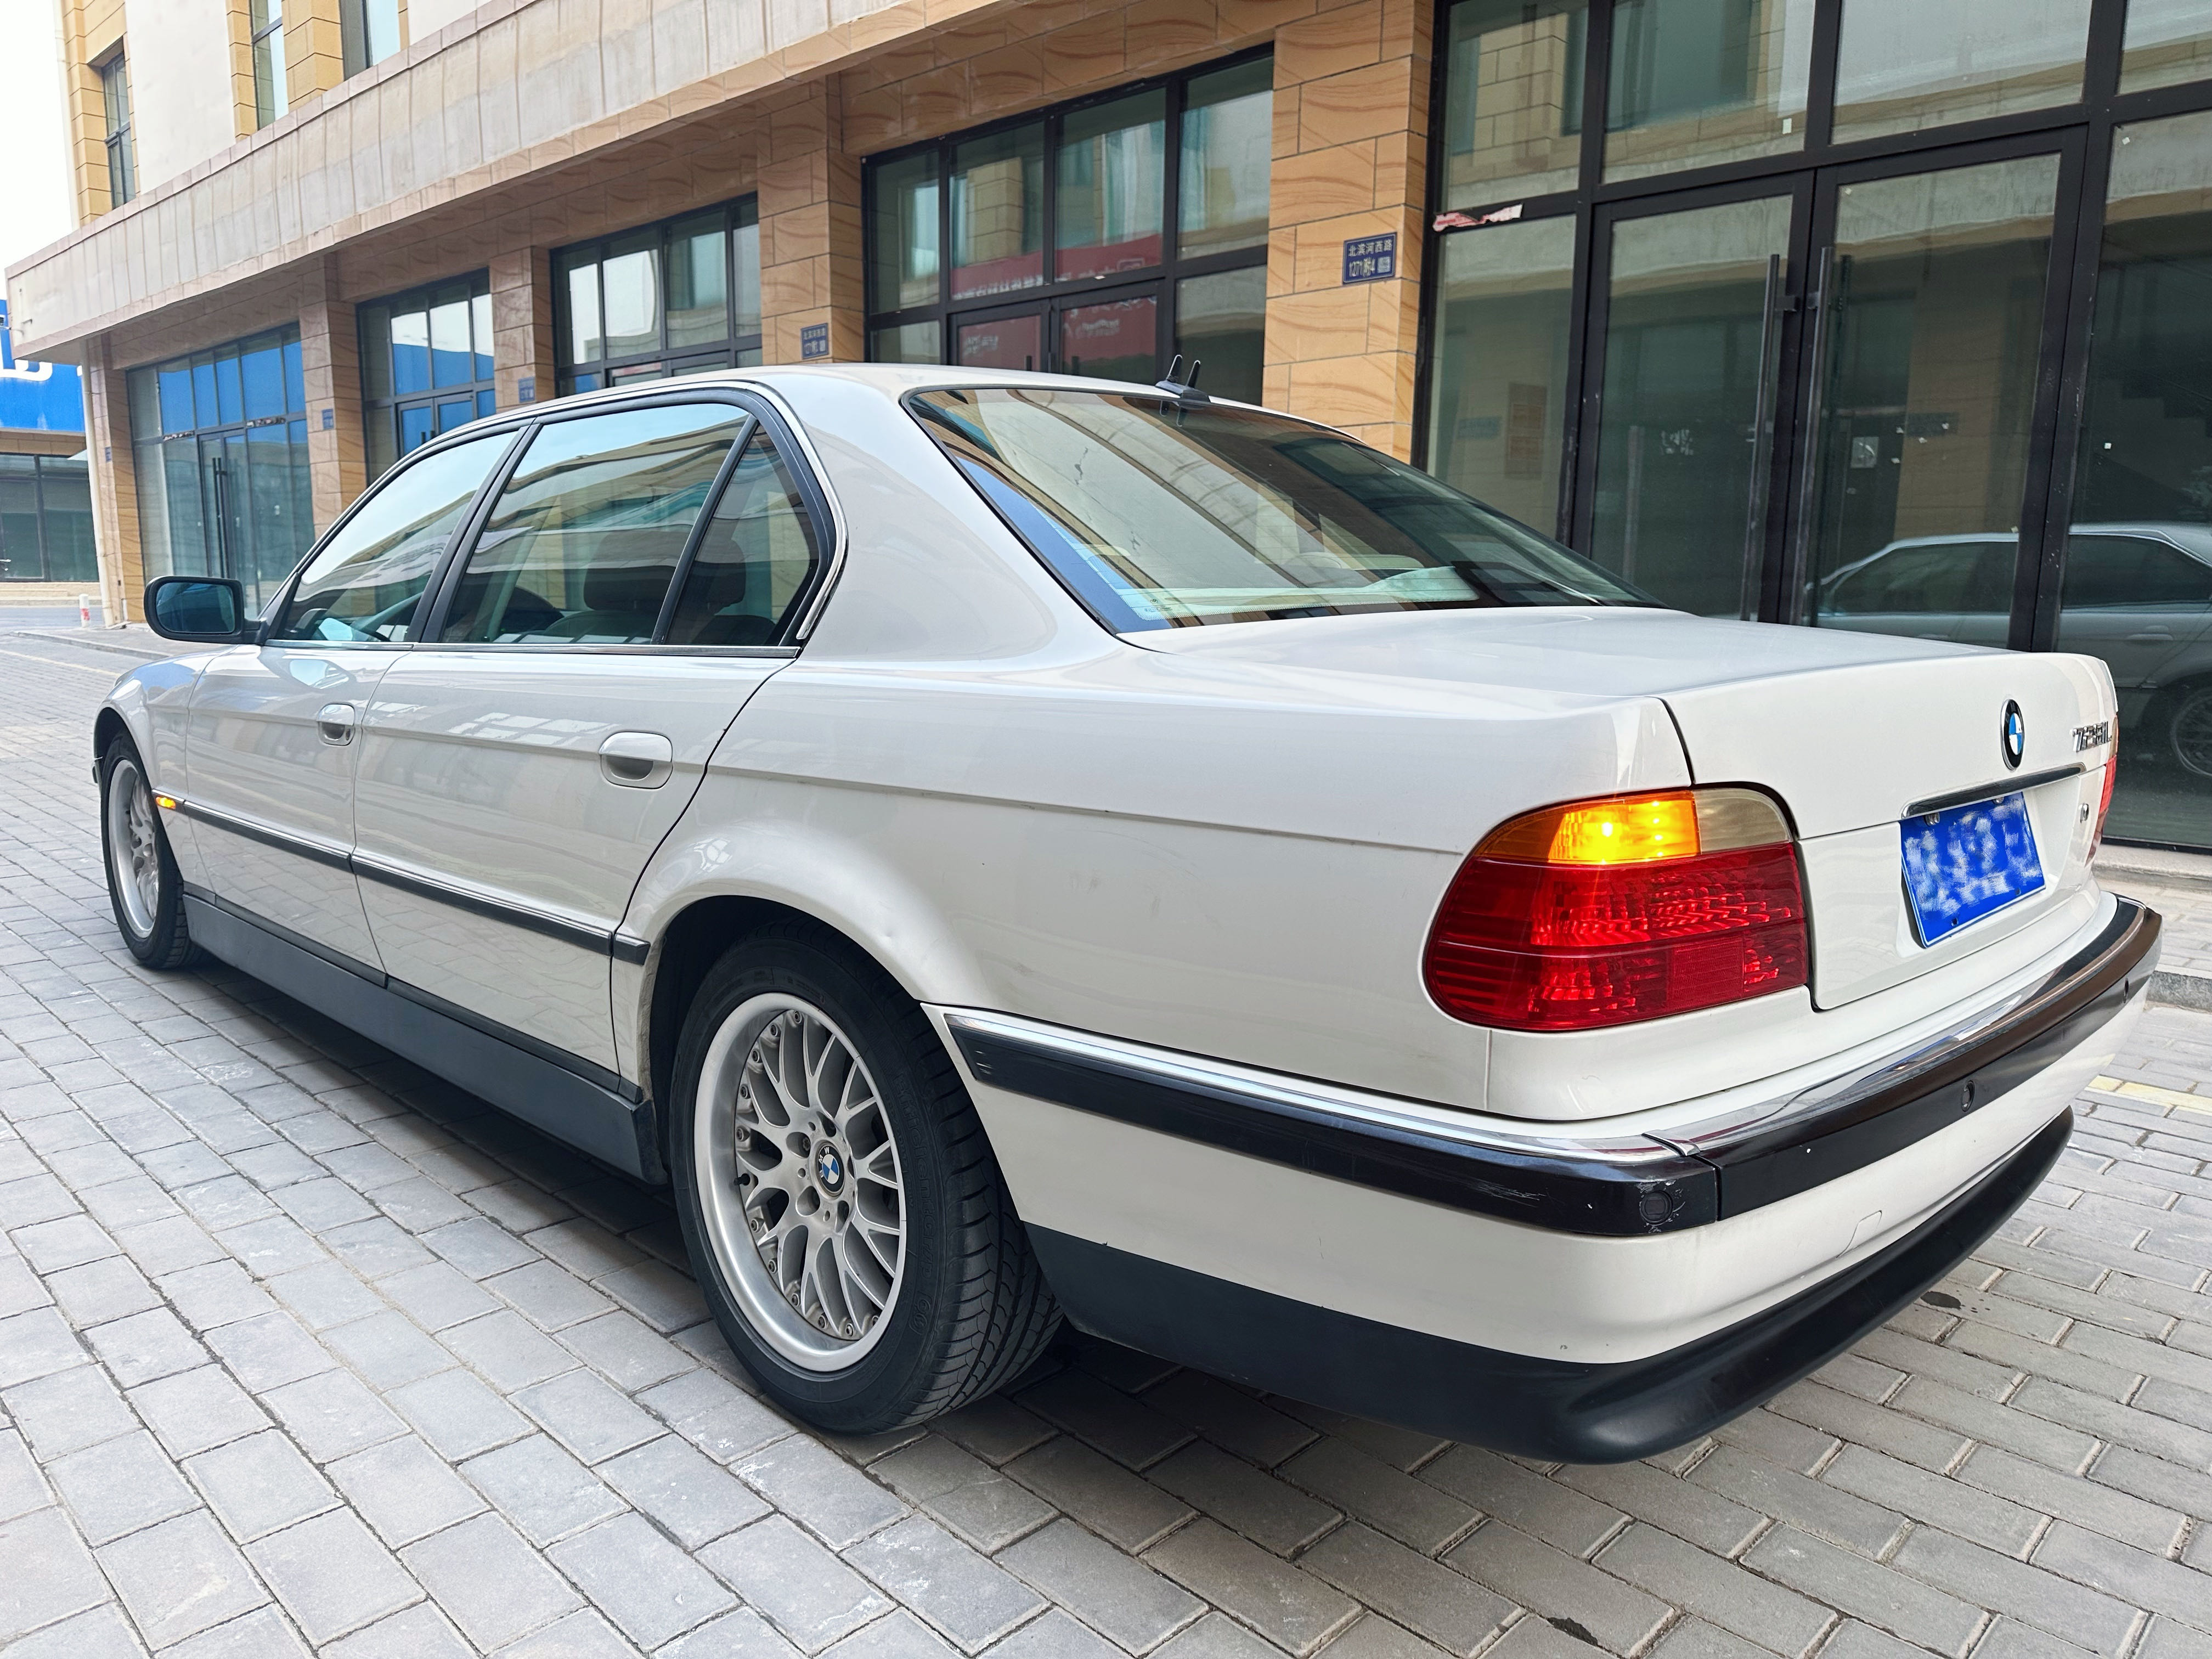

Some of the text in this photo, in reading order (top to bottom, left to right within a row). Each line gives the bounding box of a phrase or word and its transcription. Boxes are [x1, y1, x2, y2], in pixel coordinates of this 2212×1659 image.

[1348, 239, 1393, 257] 北滨河西路
